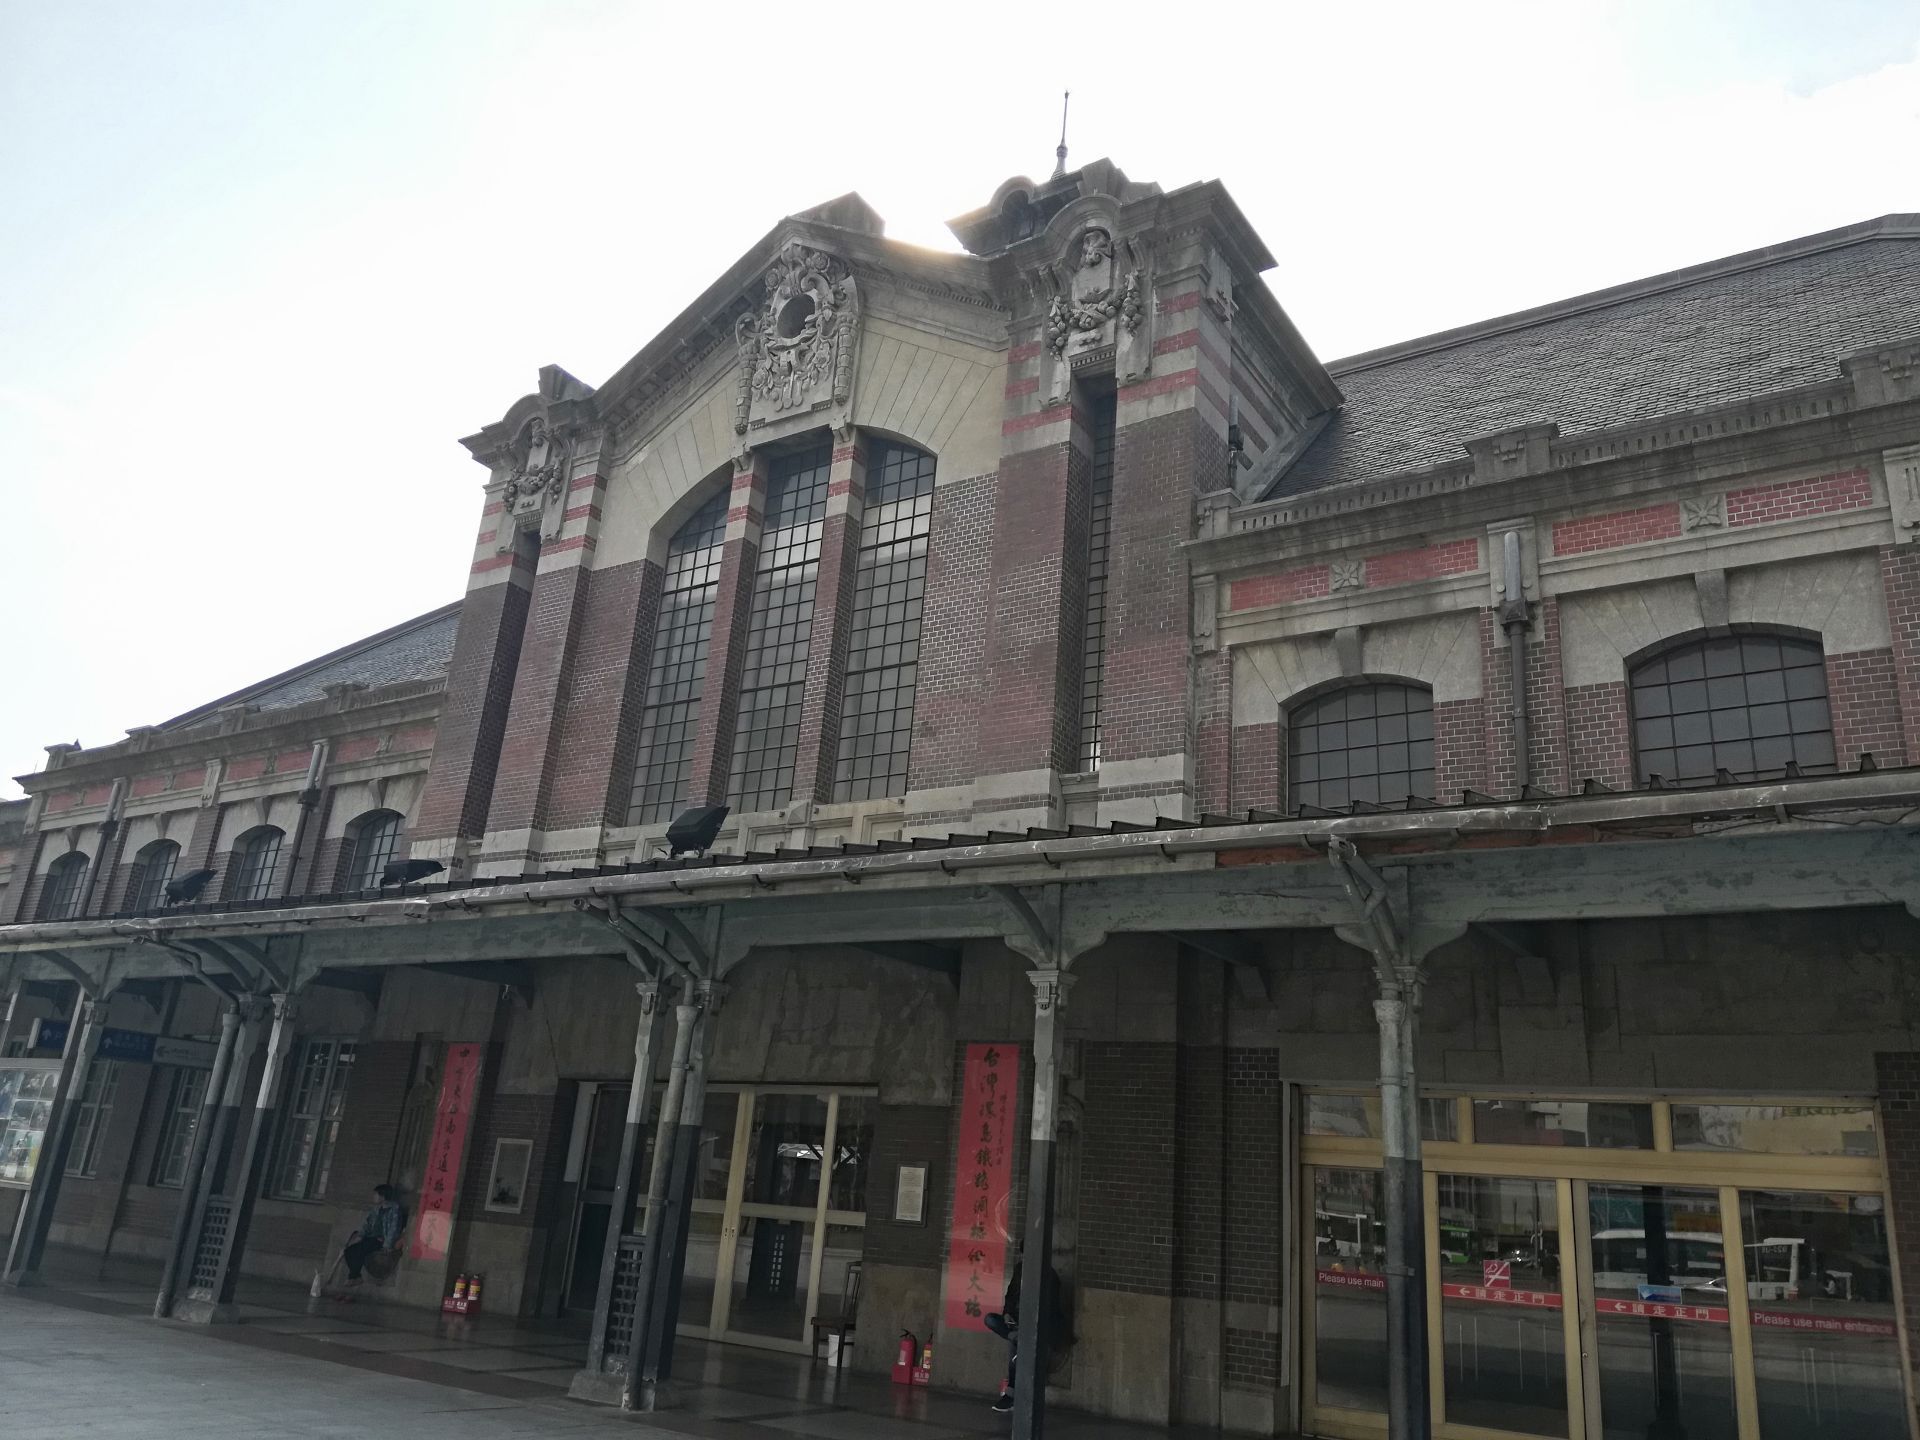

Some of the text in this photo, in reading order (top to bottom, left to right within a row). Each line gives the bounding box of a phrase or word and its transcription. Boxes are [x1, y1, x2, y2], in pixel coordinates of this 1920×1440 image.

[1318, 1272, 1384, 1288] Please use main
[1475, 1287, 1545, 1305] 請走正門
[1632, 1303, 1710, 1320] 請走正門
[1754, 1313, 1893, 1334] Please use main entrance
